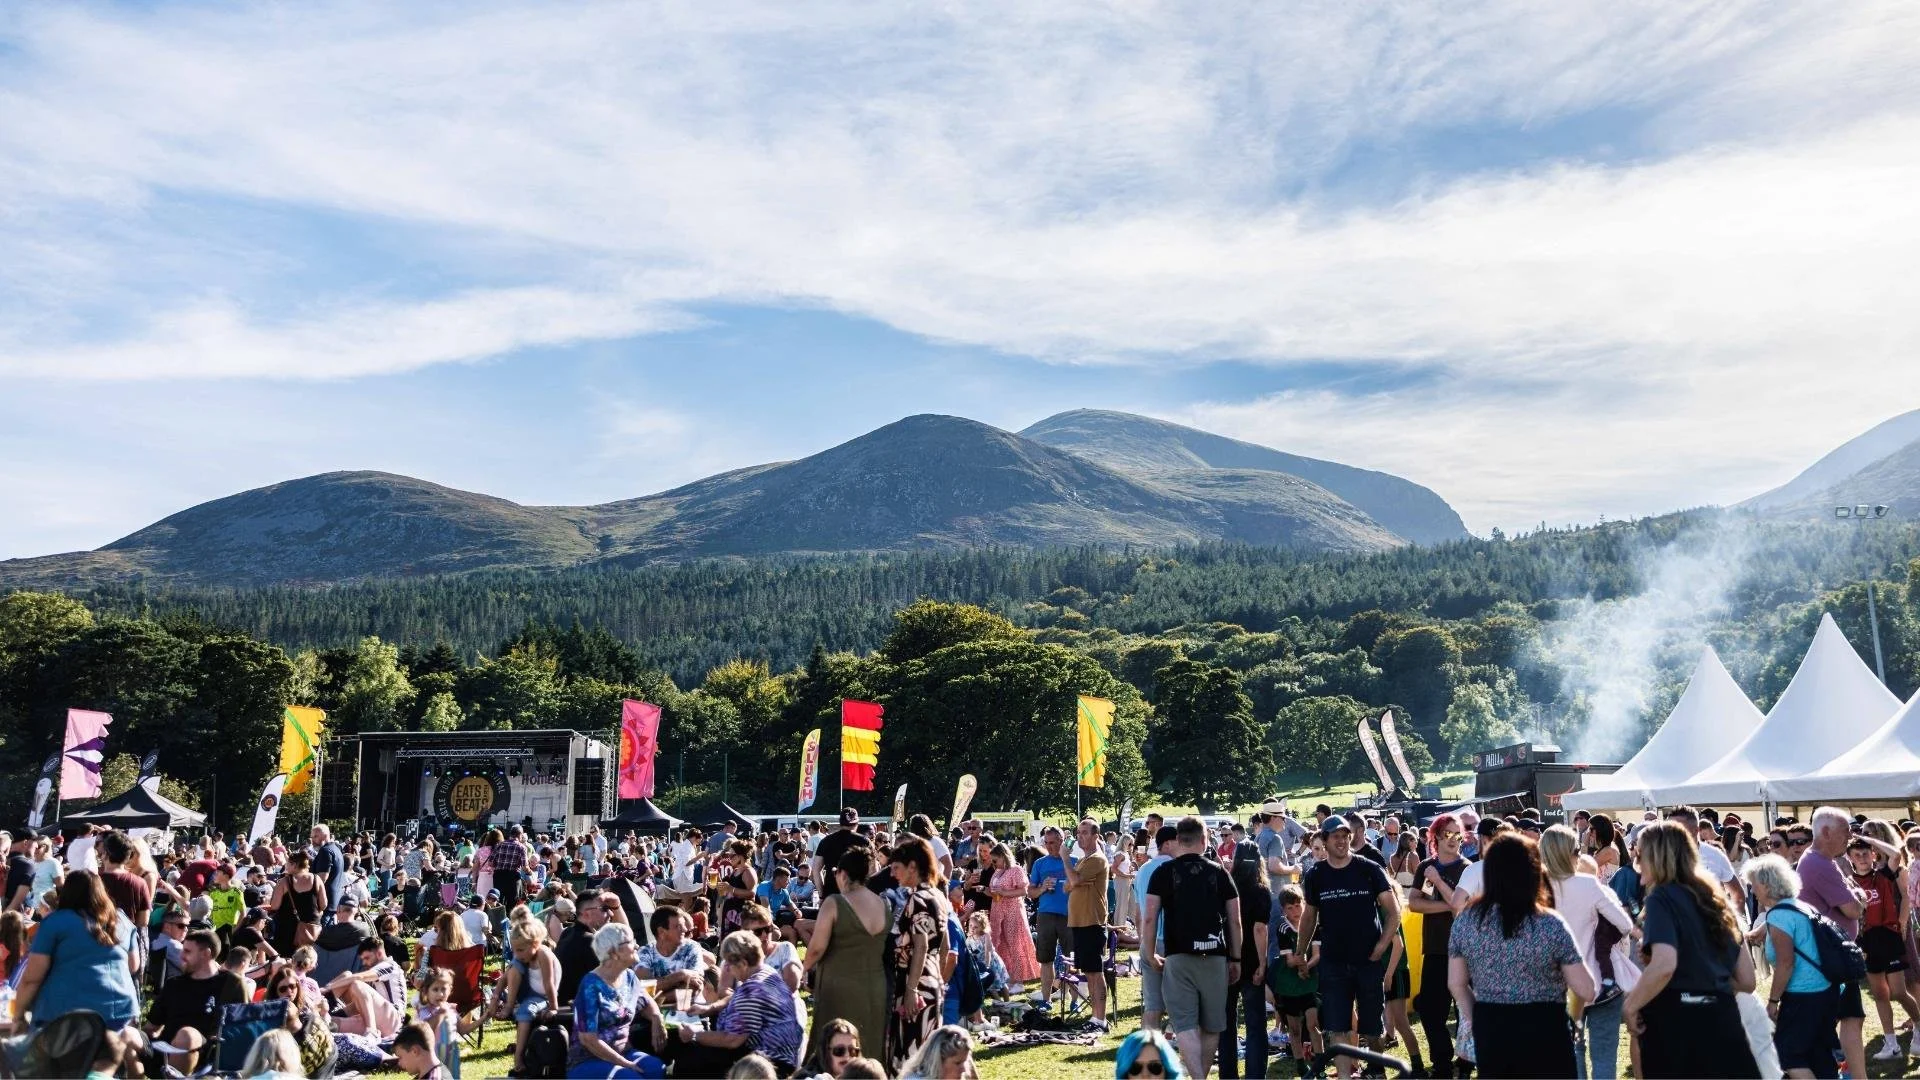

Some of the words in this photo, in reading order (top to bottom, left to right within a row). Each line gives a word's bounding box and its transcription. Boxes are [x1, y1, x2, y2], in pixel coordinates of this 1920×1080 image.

[802, 741, 816, 800] SLUSH
[440, 776, 455, 794] FOOD
[456, 784, 482, 798] EATS
[454, 798, 489, 812] BEATS
[720, 864, 734, 881] 10
[1193, 940, 1218, 950] PUMA
